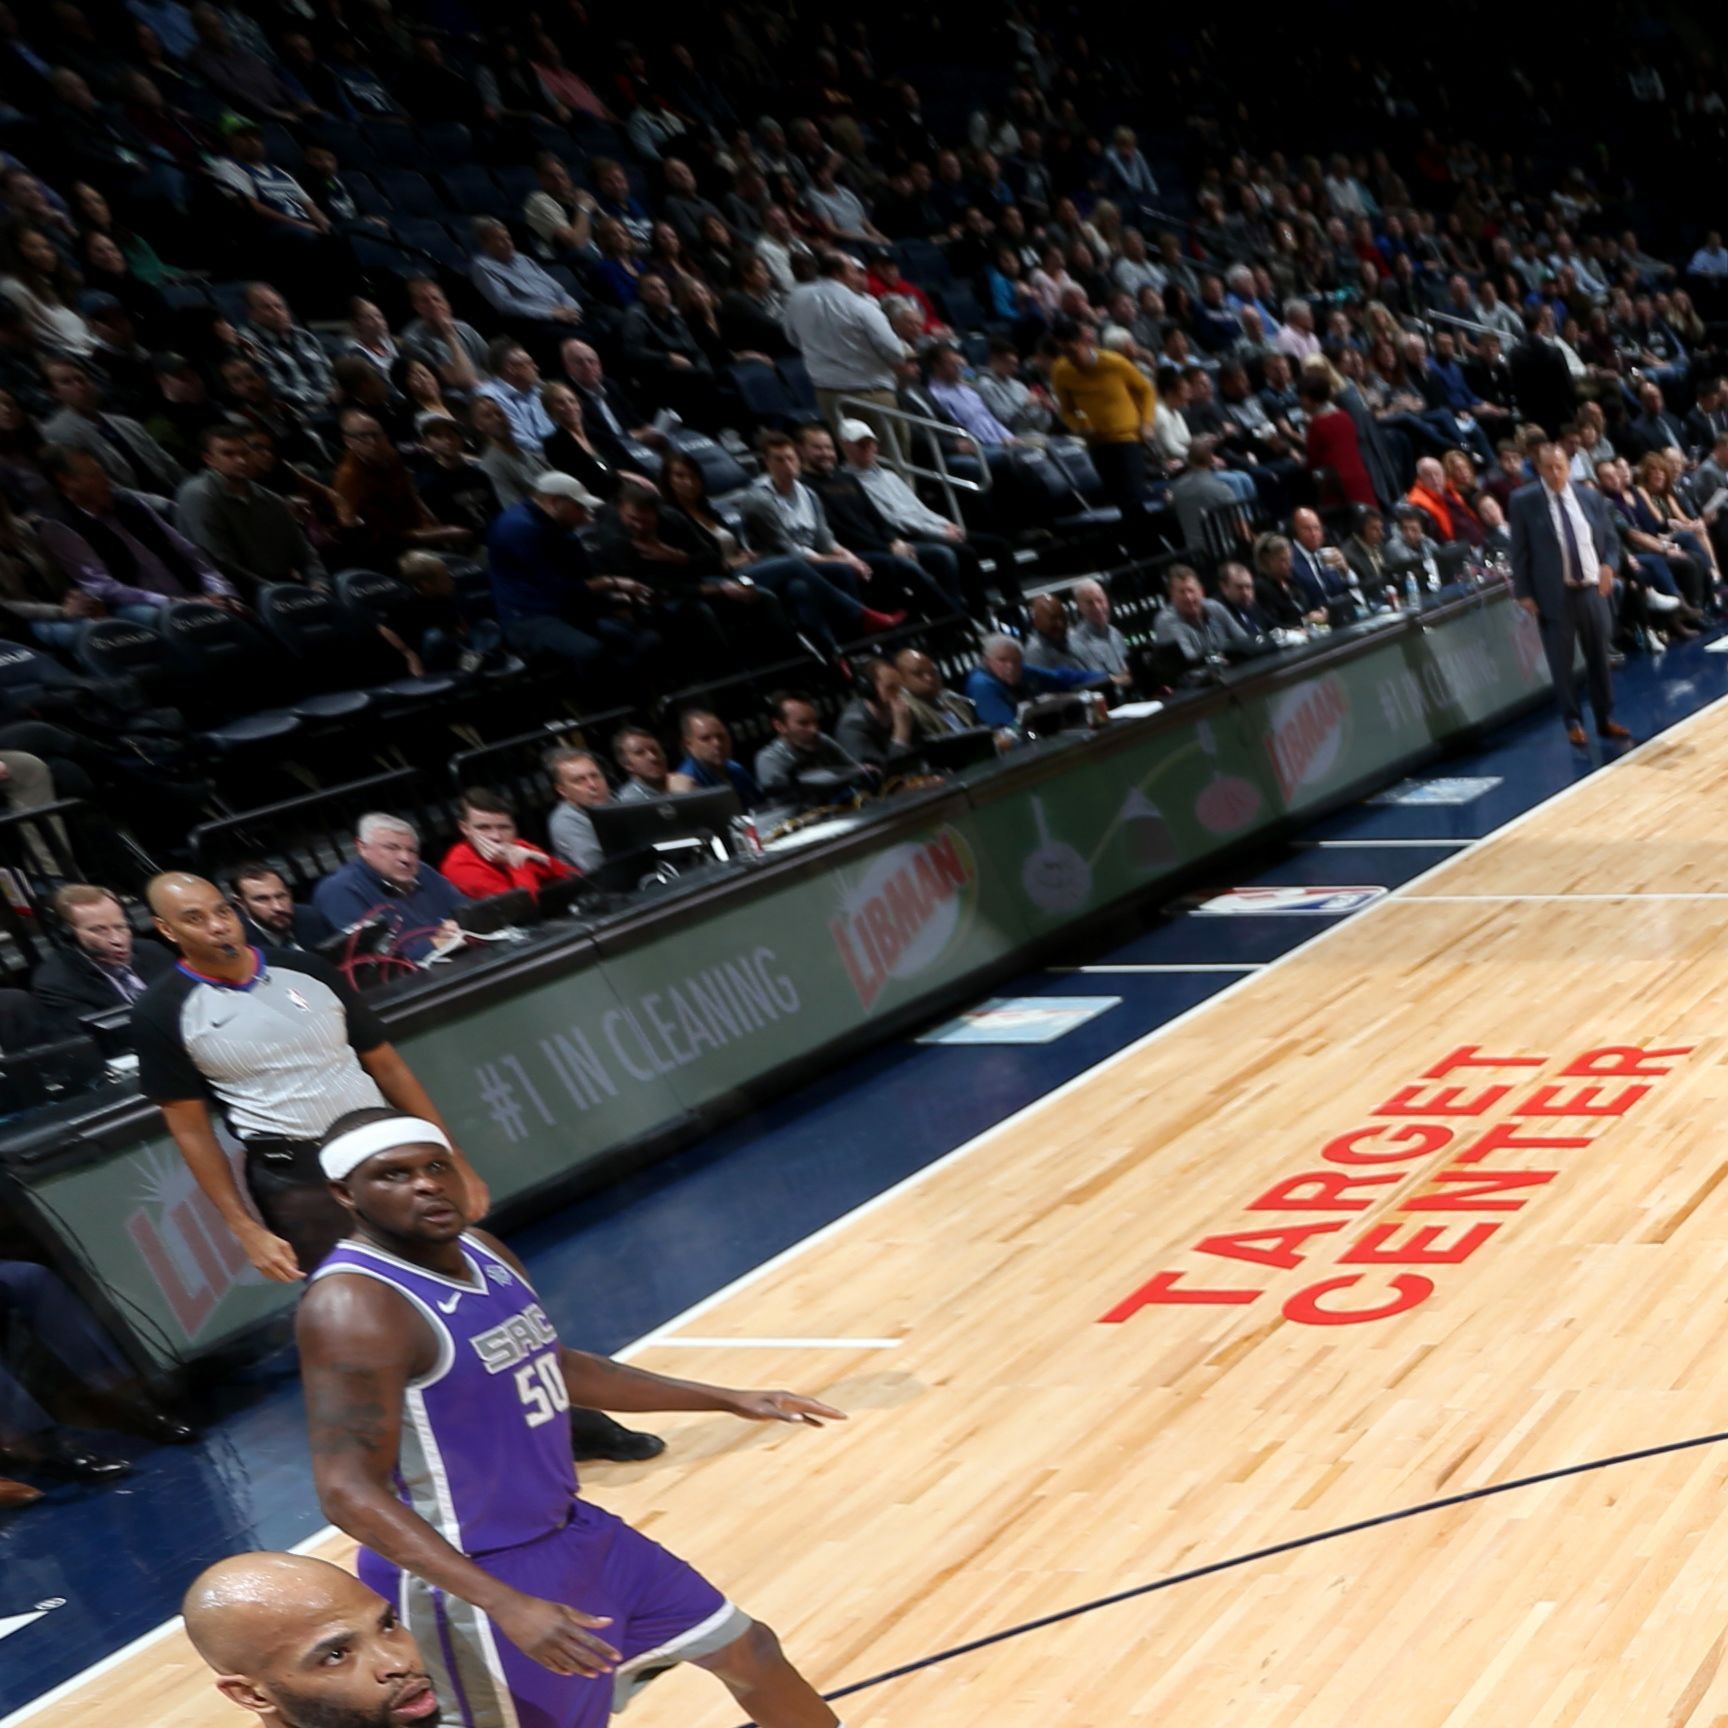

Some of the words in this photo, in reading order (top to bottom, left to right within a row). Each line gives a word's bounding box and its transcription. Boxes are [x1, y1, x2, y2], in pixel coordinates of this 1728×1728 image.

[827, 832, 967, 1013] LIBMAN
[475, 1054, 557, 1143] #1
[538, 1026, 620, 1111] IN
[602, 946, 800, 1082] CLEANING
[1093, 1045, 1550, 1324] TARGET
[1281, 1045, 1697, 1326] CENTER
[468, 1302, 558, 1375] SAC
[513, 1352, 569, 1429] 50
